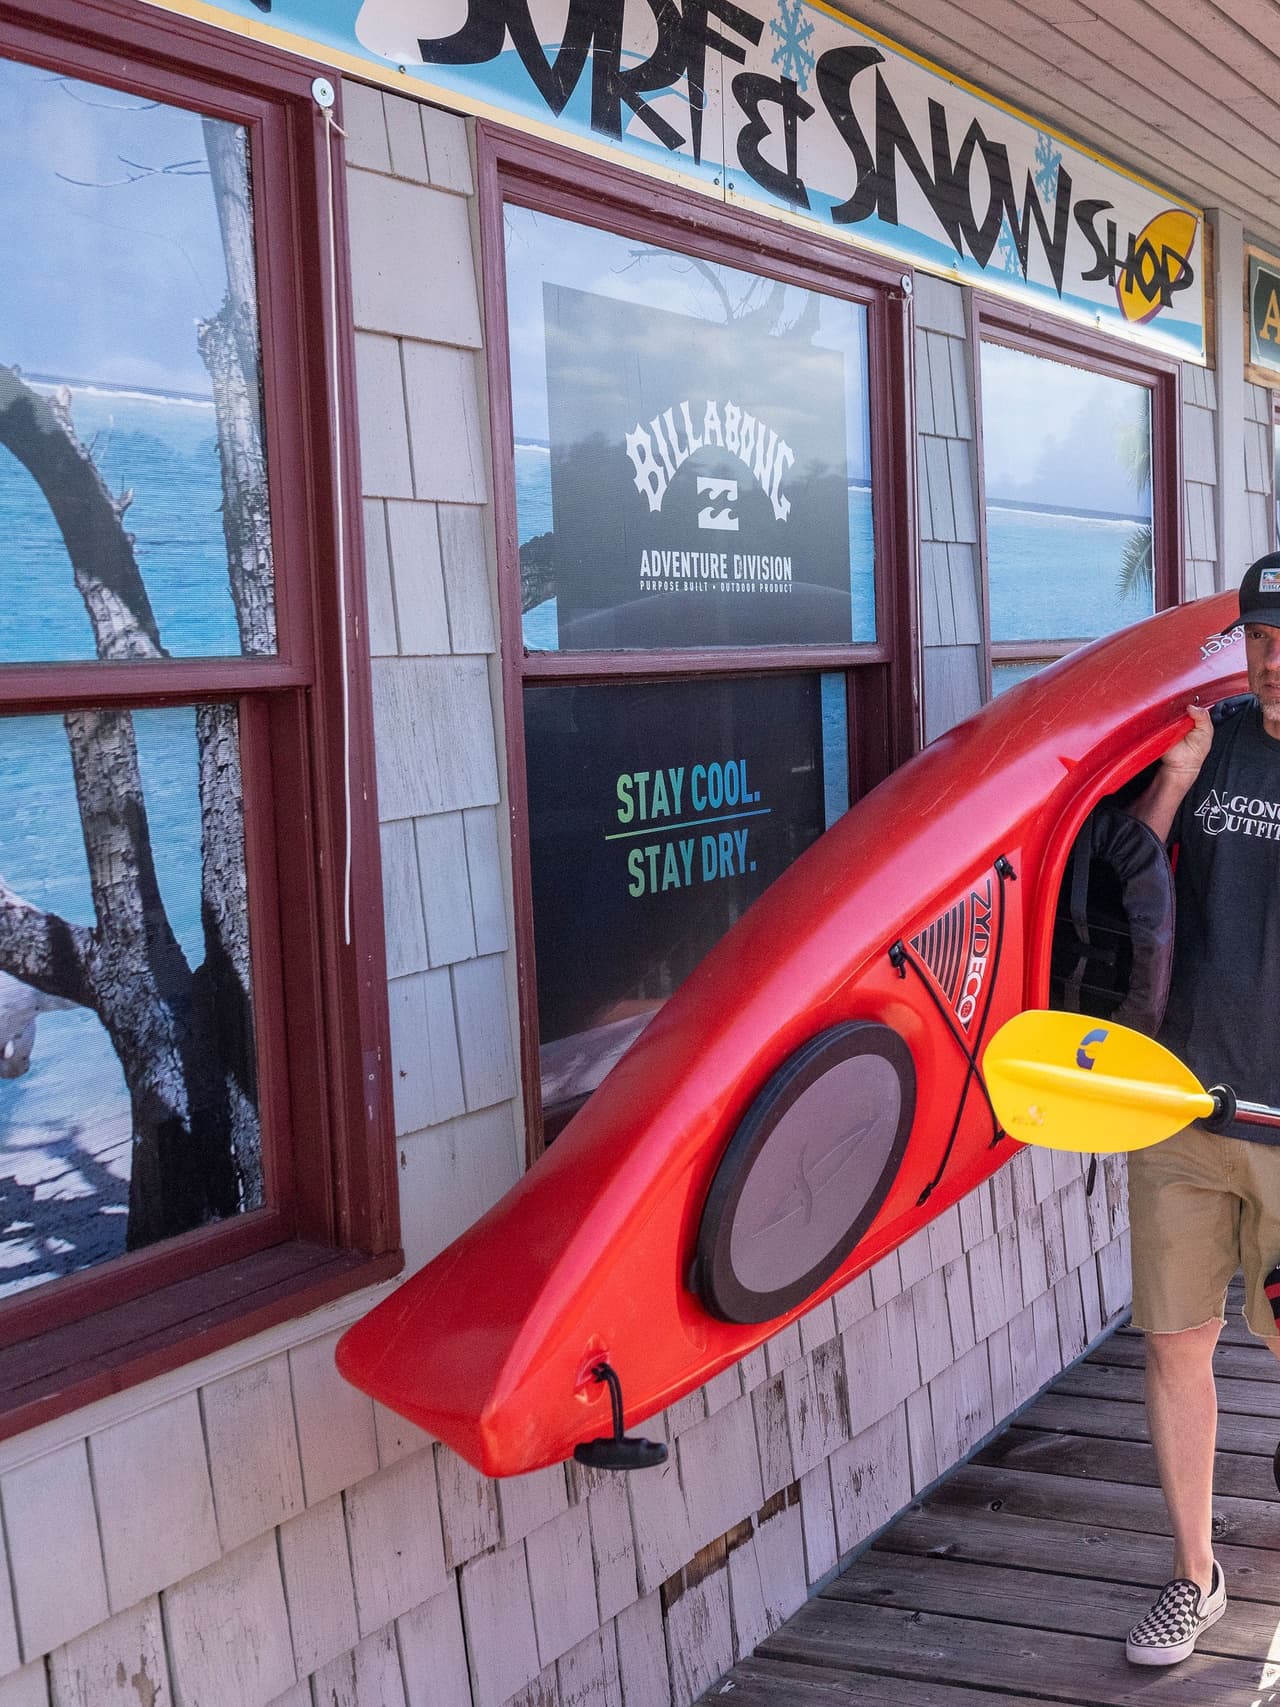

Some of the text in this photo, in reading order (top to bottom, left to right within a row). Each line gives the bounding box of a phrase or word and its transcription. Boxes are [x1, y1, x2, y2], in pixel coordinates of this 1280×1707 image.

[731, 75, 815, 211] &
[816, 45, 1073, 299] SNOW
[1074, 199, 1194, 308] SHOP
[625, 400, 795, 522] BILLABONG
[639, 549, 792, 581] ADVENTURE DIVISION
[640, 581, 793, 593] PURPOSE BUILT OUTDOOR PRODUCT
[1200, 624, 1245, 660] gger
[616, 759, 760, 824] STAY COOL.
[628, 828, 757, 898] STAY DRY.
[956, 878, 992, 1024] ZYDECO
